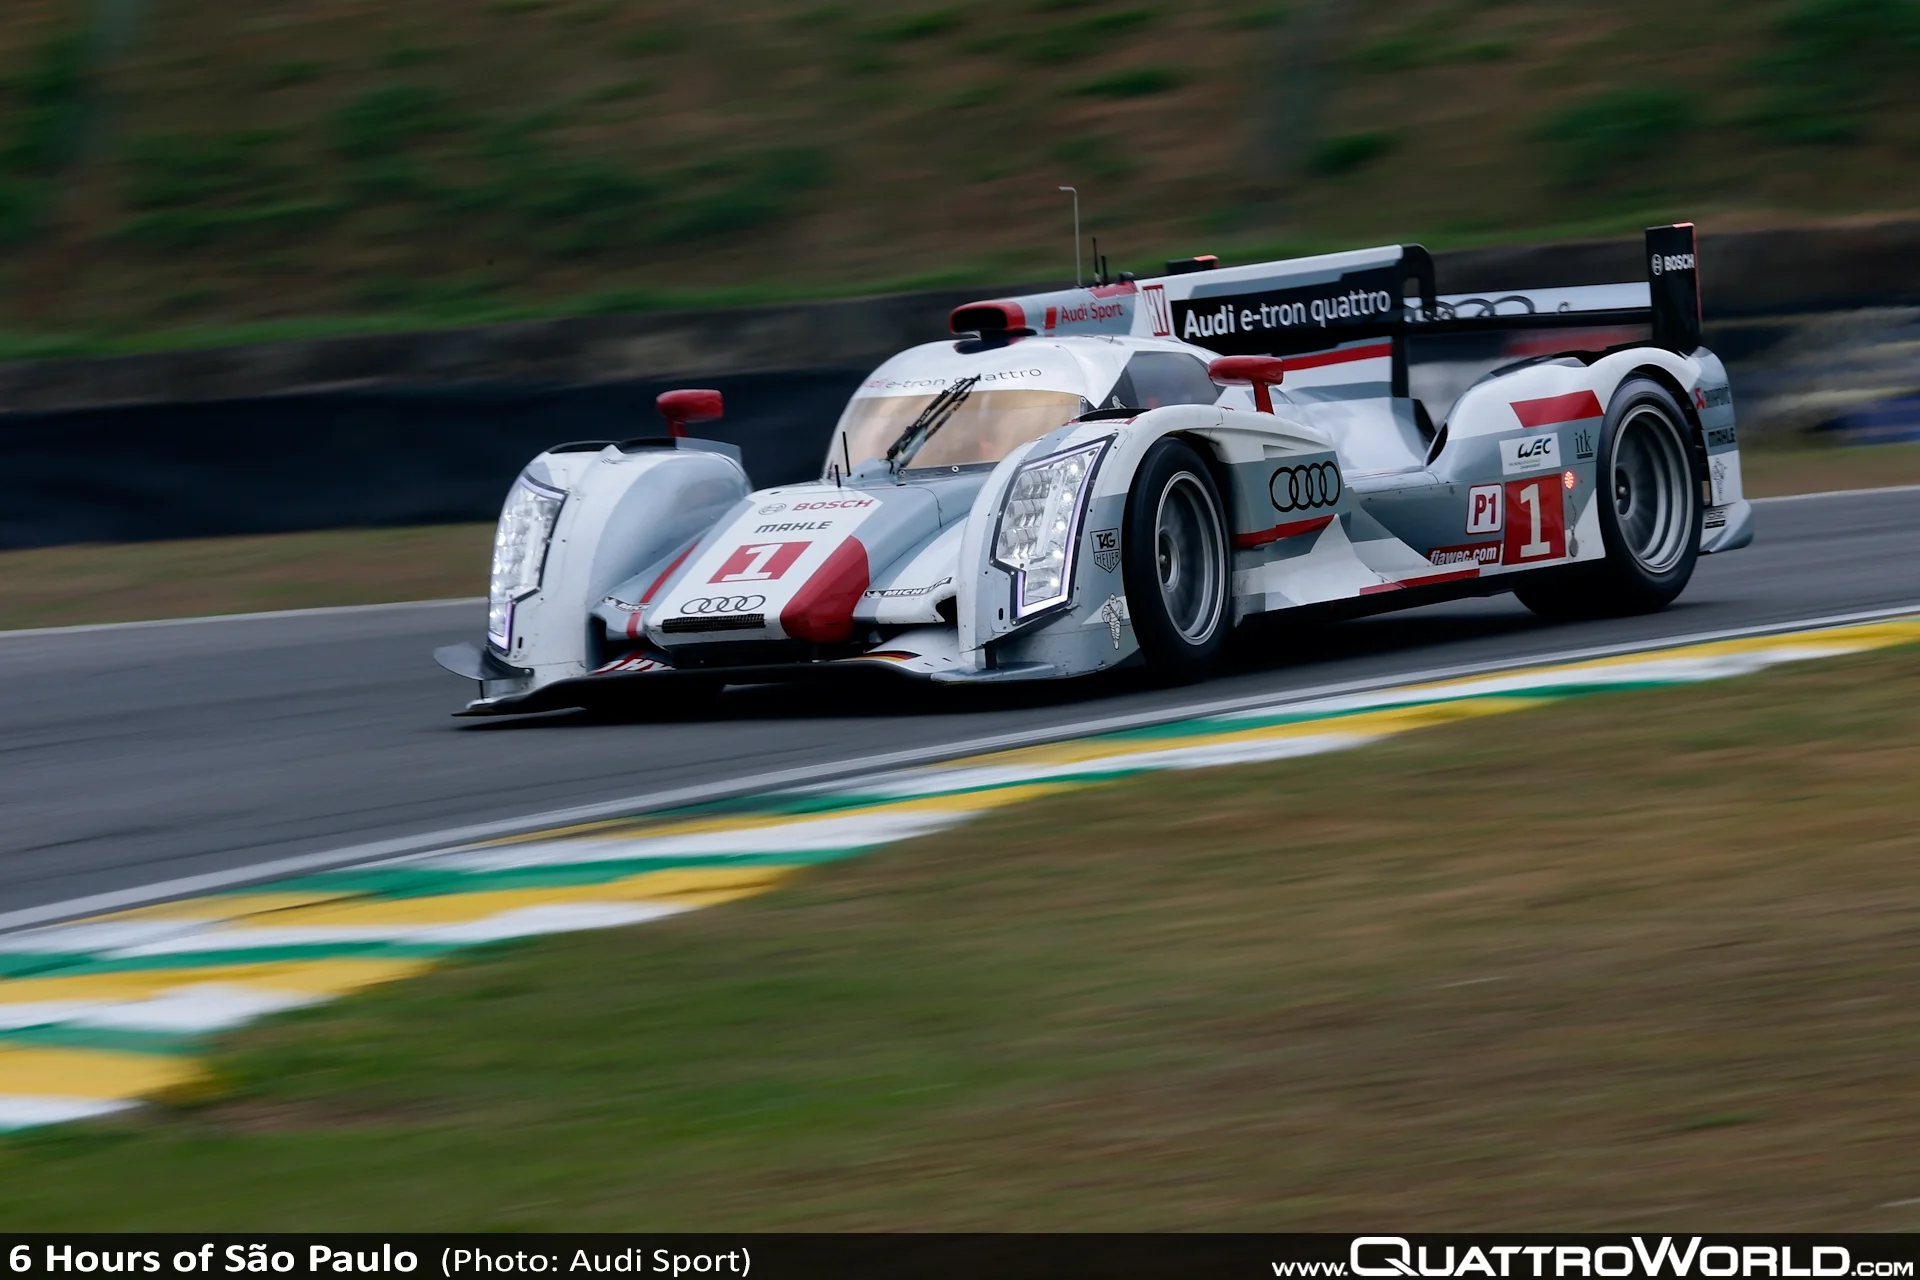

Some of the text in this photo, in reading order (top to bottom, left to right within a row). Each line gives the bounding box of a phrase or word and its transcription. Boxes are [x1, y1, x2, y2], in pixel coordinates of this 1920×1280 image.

[1664, 253, 1695, 271] BOSCH
[1061, 301, 1123, 323] Audi Sport
[1183, 289, 1391, 339] Audi e-tron quattro
[885, 377, 946, 389] e-tron
[1517, 437, 1552, 459] WEC
[1575, 428, 1592, 453] itk
[792, 499, 875, 512] BOSCH
[1473, 493, 1496, 526] P1
[754, 520, 833, 534] MAHLE
[1520, 483, 1551, 558] 1
[1096, 531, 1116, 550] TAG
[721, 543, 775, 581] 1
[1096, 551, 1120, 570] HEUER
[1430, 545, 1497, 566] fiawec.com
